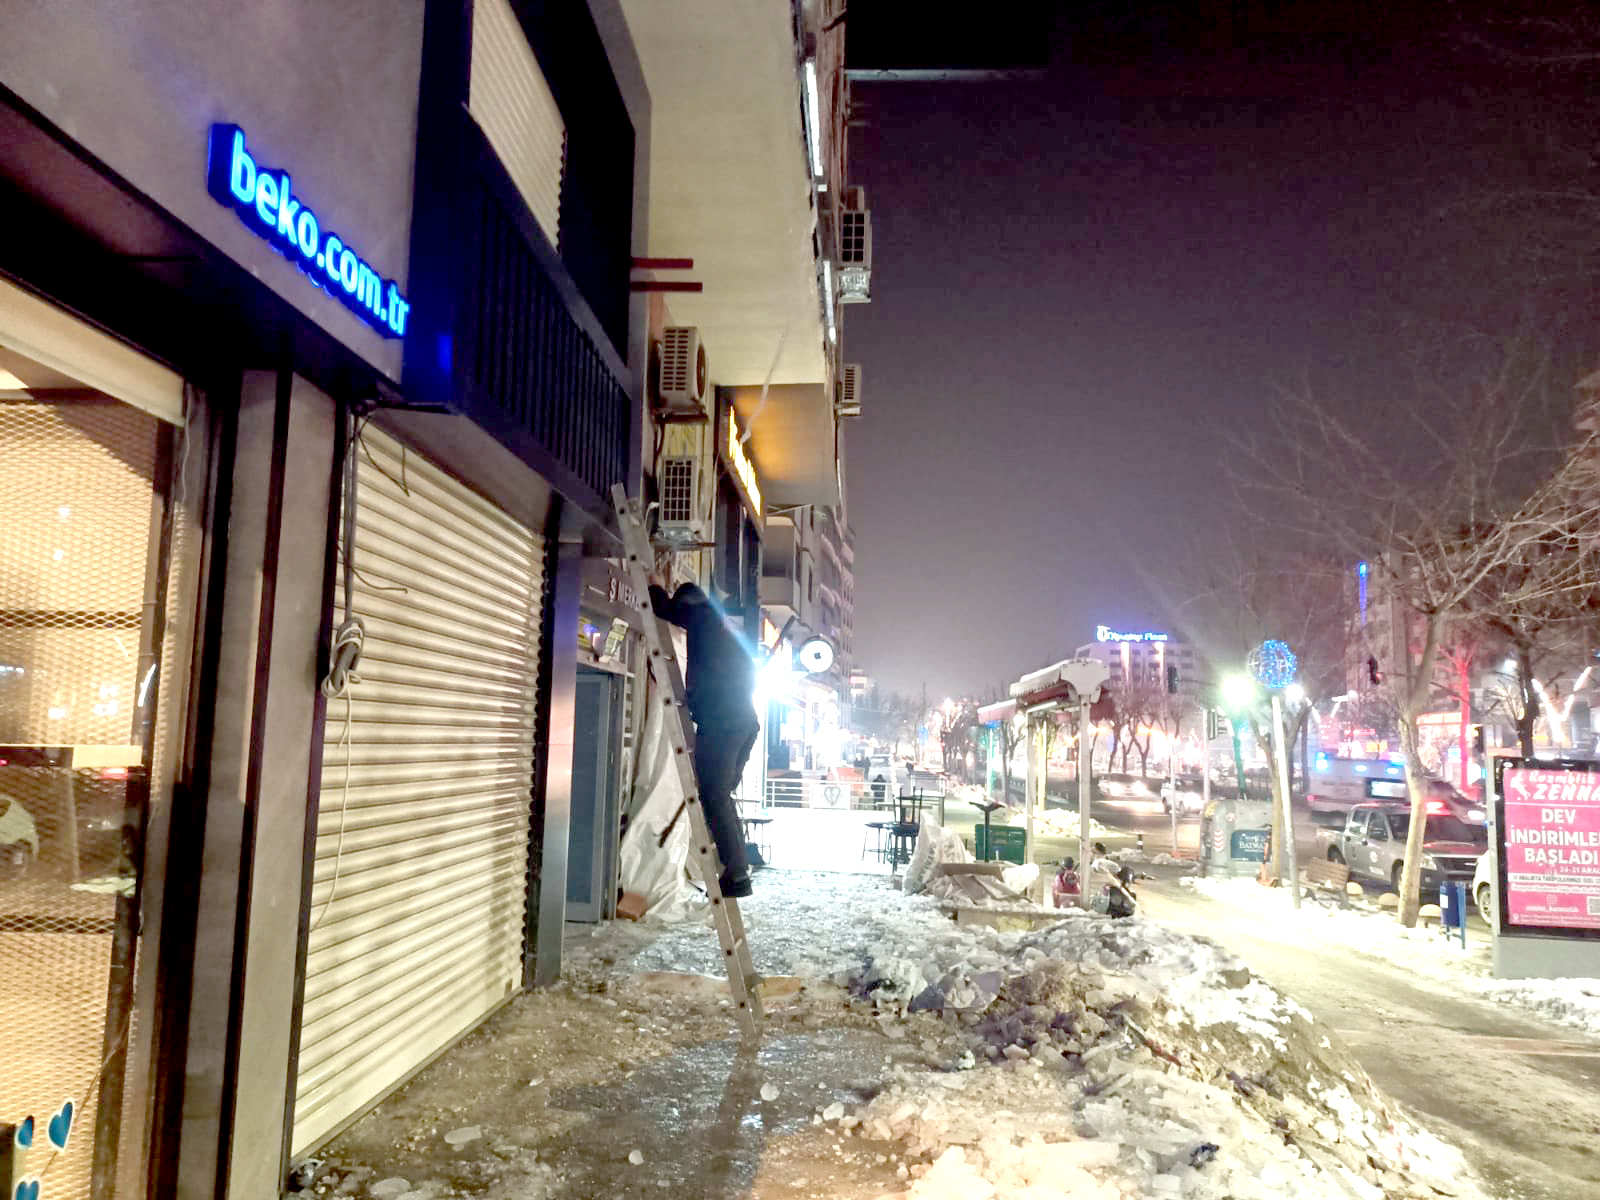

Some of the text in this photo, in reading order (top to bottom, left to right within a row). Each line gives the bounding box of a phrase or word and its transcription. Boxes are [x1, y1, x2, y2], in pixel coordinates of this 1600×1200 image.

[229, 128, 411, 337] beko.com.tr
[1541, 808, 1577, 824] DEV
[1510, 824, 1600, 847] İNDİRİMLE
[1524, 847, 1599, 868] BAŞLADI
